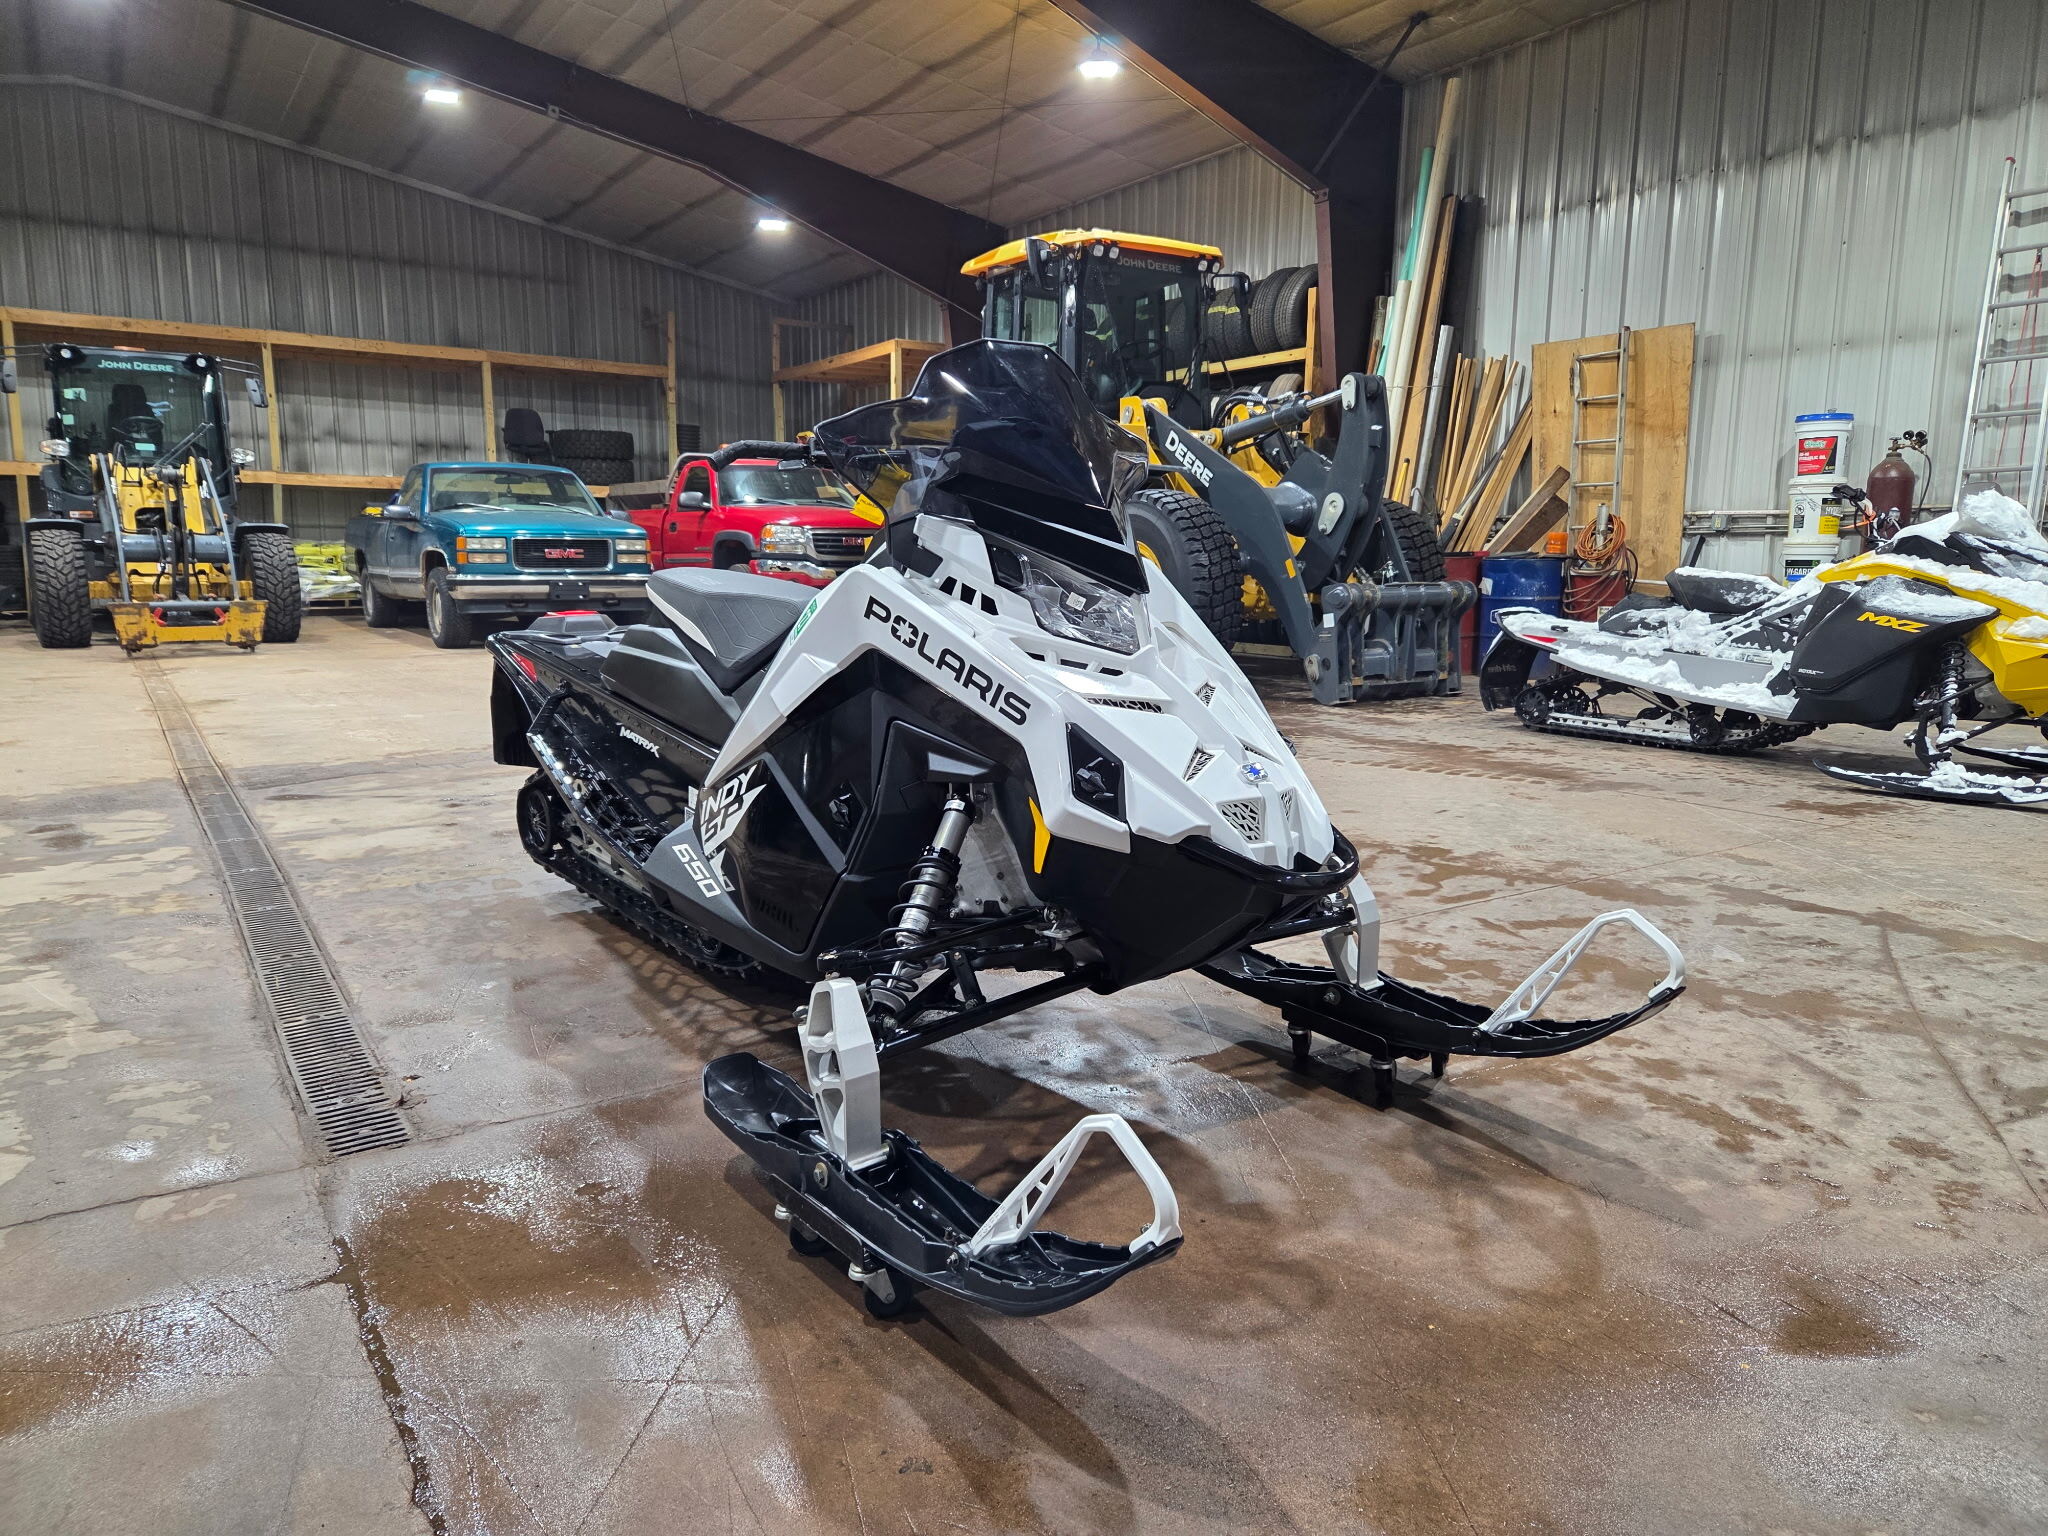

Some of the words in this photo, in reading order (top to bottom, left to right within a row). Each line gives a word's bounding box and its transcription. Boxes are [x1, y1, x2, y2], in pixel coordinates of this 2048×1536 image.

[1117, 256, 1146, 269] JOHN
[1147, 260, 1182, 274] DEERE
[98, 360, 132, 370] JOHN
[133, 362, 174, 373] DEERE
[1165, 430, 1214, 488] DEERE
[545, 548, 585, 559] GMC
[1857, 611, 1930, 633] MXZ
[864, 595, 1031, 726] POLARIS
[701, 764, 758, 826] INDY
[671, 844, 722, 898] 650
